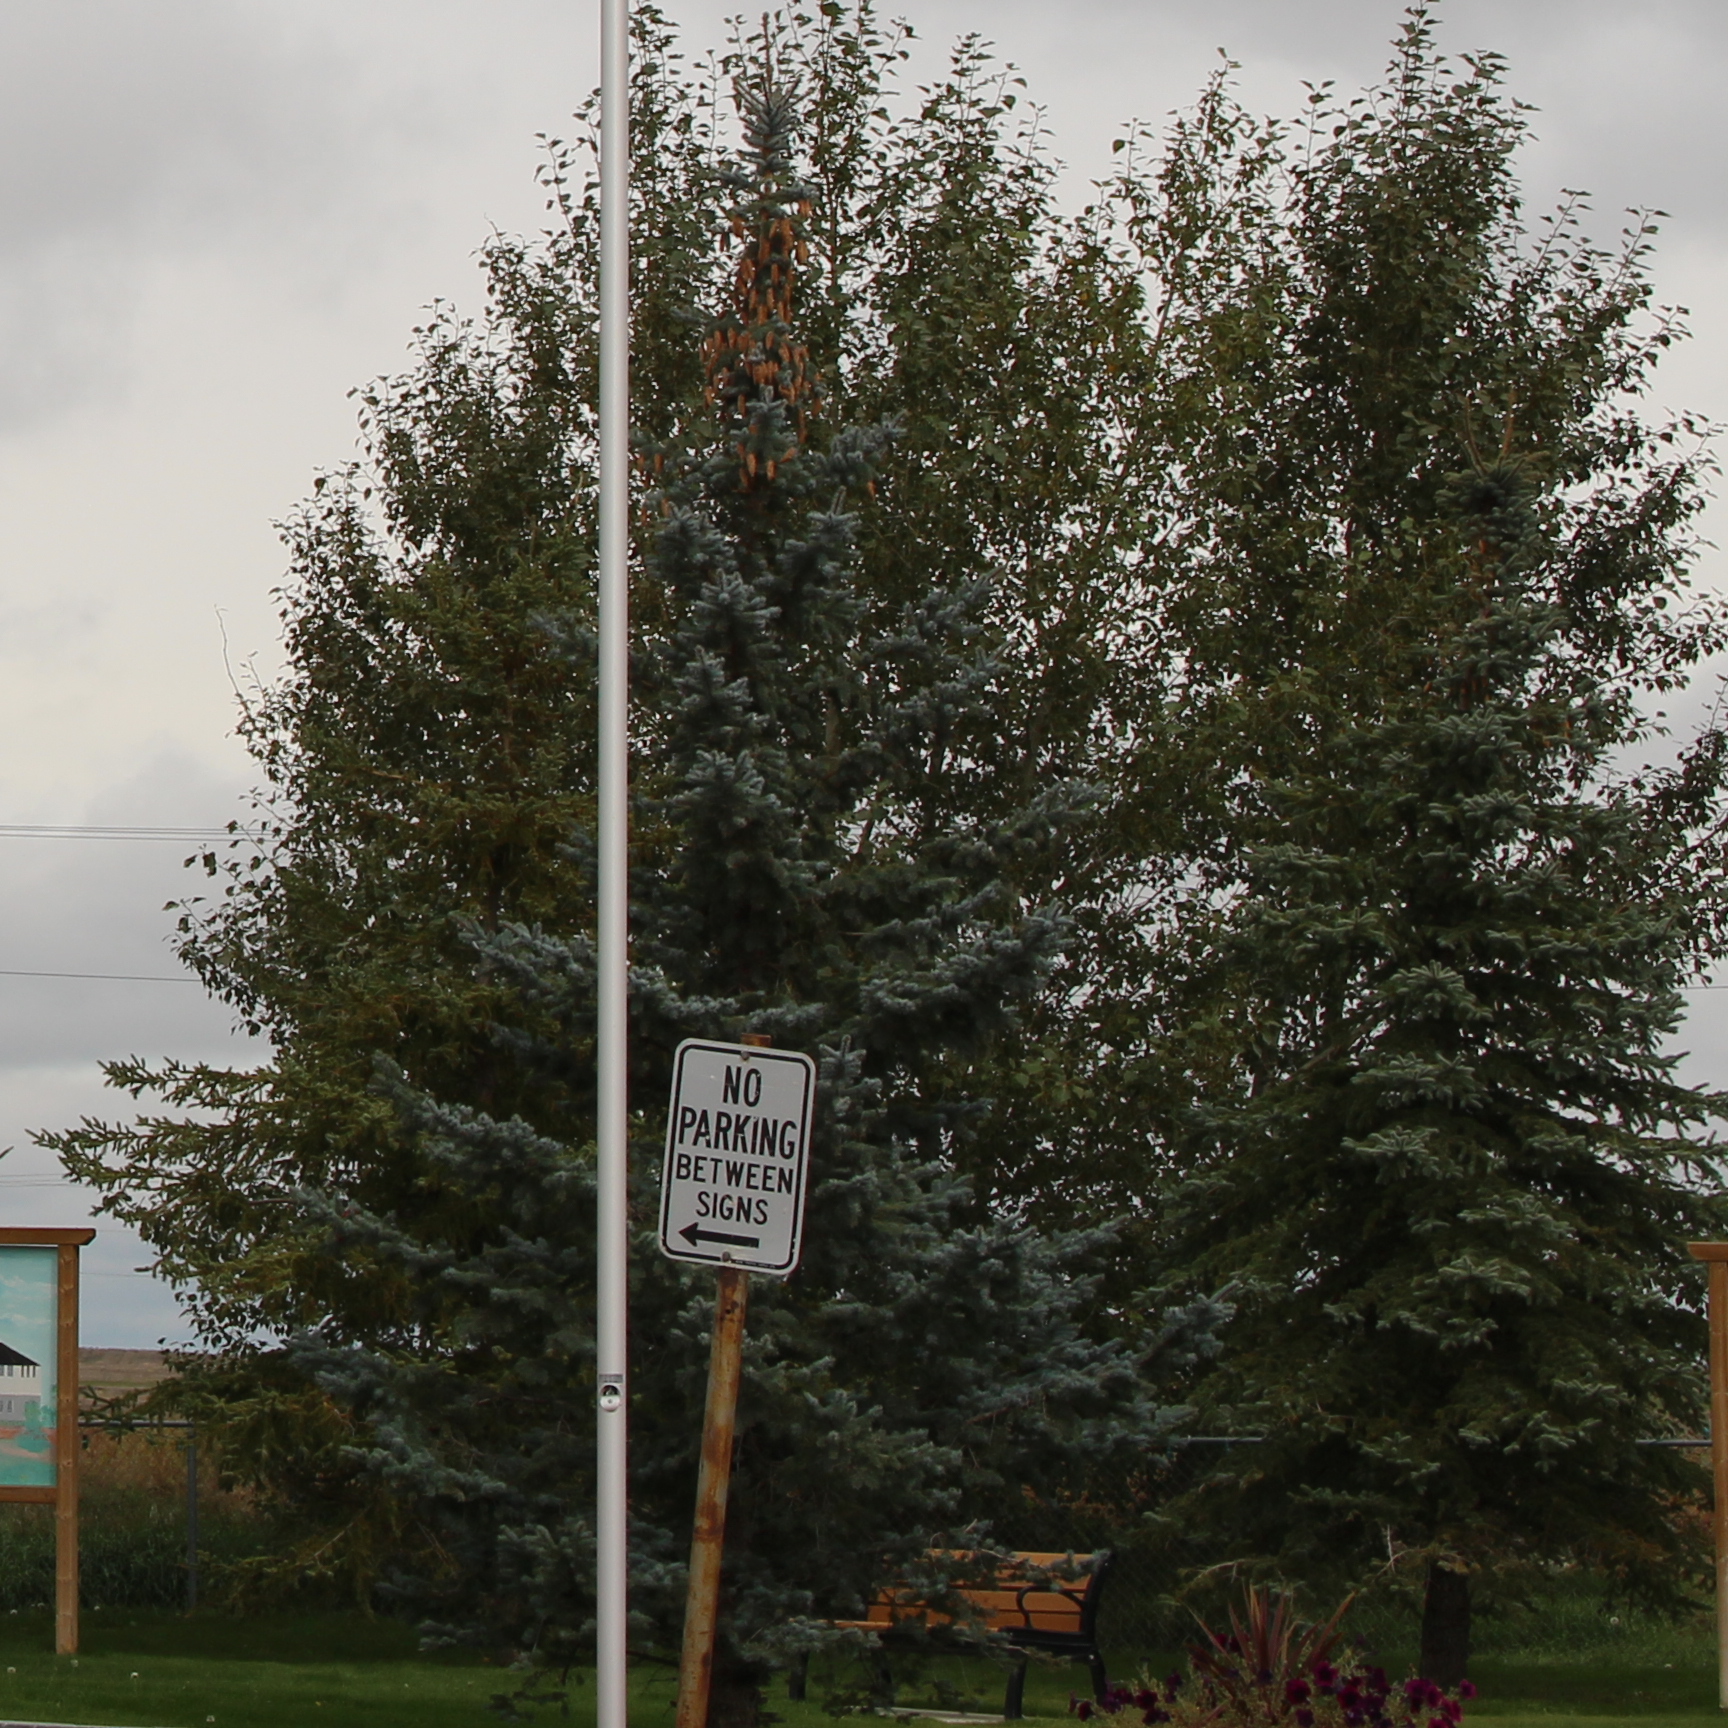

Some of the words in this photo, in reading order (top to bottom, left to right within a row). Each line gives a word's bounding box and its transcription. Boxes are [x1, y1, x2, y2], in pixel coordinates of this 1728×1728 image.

[722, 1065, 762, 1107] NO
[678, 1105, 797, 1160] PARKING
[675, 1152, 793, 1195] BETWEEN
[695, 1190, 769, 1225] SIGNS
